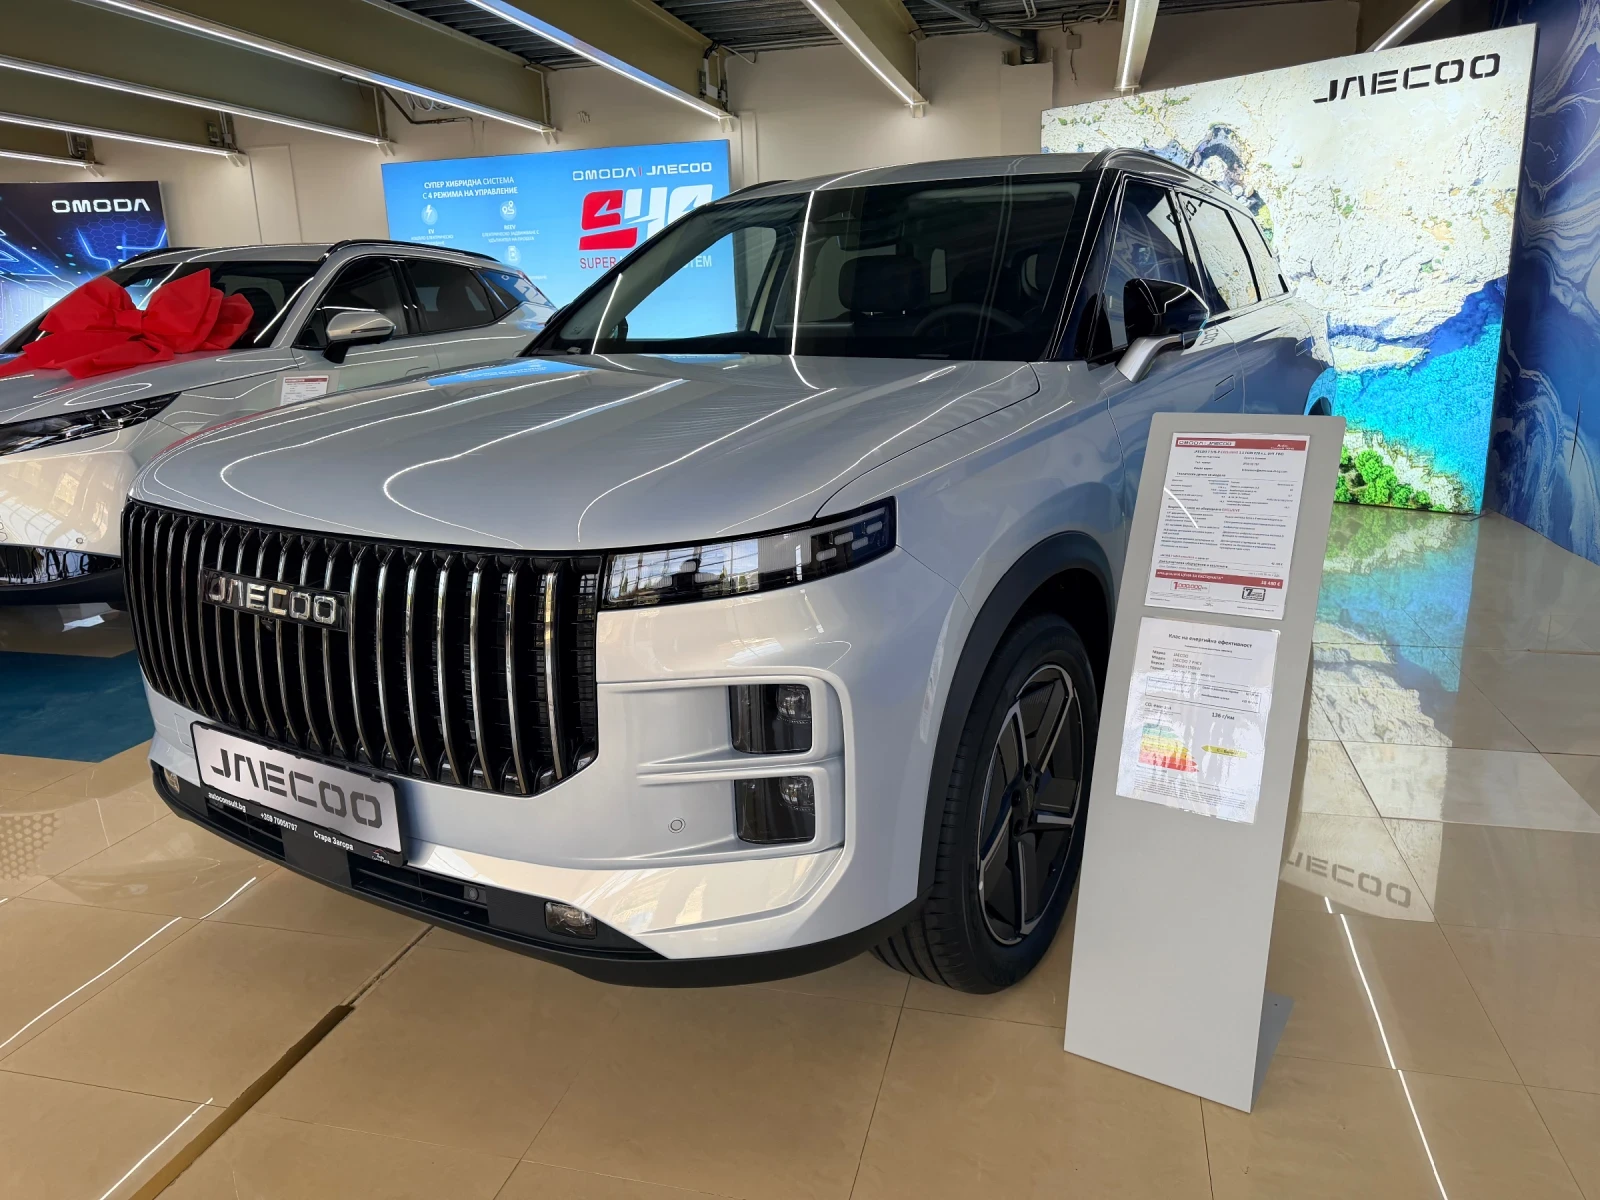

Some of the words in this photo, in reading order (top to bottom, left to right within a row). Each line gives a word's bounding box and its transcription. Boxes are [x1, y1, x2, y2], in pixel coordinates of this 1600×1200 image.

[1313, 53, 1501, 104] JAECOO
[572, 167, 637, 181] OMODA
[646, 161, 713, 176] JAECOO
[424, 181, 445, 189] СУПЕР
[445, 178, 482, 188] ХИБРИДНА
[482, 176, 515, 185] СИСТЕМА
[433, 190, 463, 199] РЕЖИМА
[464, 189, 474, 197] НА
[475, 186, 518, 196] УПРАВЛЕНИЕ
[51, 198, 151, 213] OMODA
[579, 256, 616, 269] SUPER
[208, 576, 337, 625] JAECOO
[210, 748, 383, 829] JAECOO
[208, 792, 247, 813] autoconsult.bg
[313, 830, 332, 844] Стара
[332, 835, 354, 851] Загора
